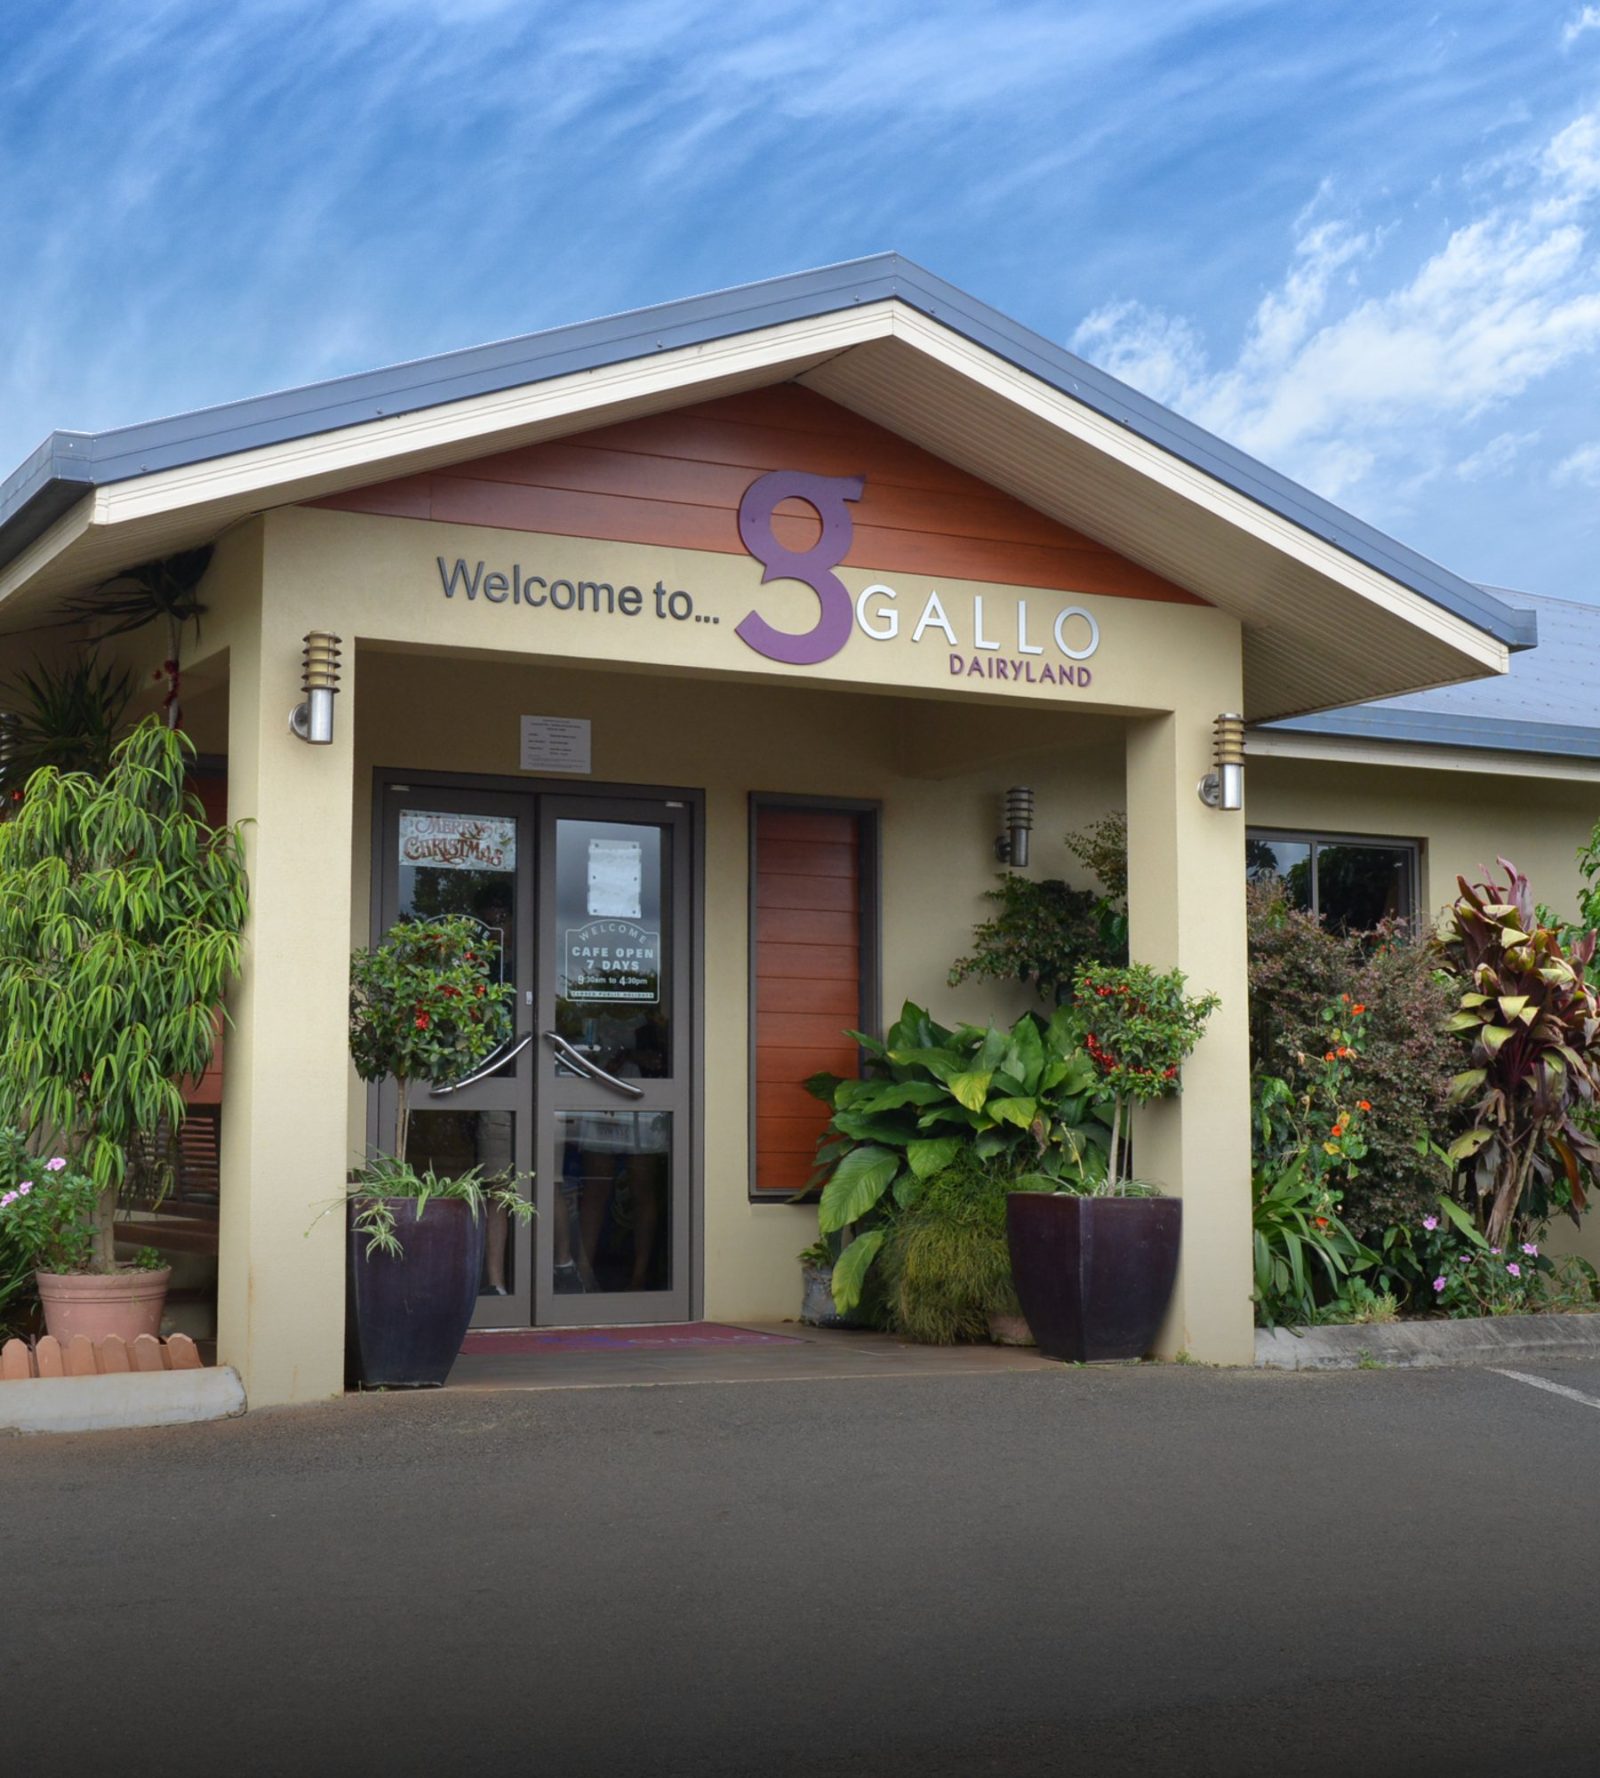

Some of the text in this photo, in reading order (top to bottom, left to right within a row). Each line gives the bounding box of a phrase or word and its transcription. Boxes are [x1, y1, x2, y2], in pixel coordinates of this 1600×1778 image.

[436, 556, 720, 624] Welcome to...
[855, 584, 1100, 660] GALLO
[949, 653, 1092, 688] DAIRYLAND
[579, 923, 647, 944] WELCOME
[572, 946, 654, 959] CAFE OPEN
[586, 960, 640, 971] 7 DAYS
[608, 976, 618, 984] to
